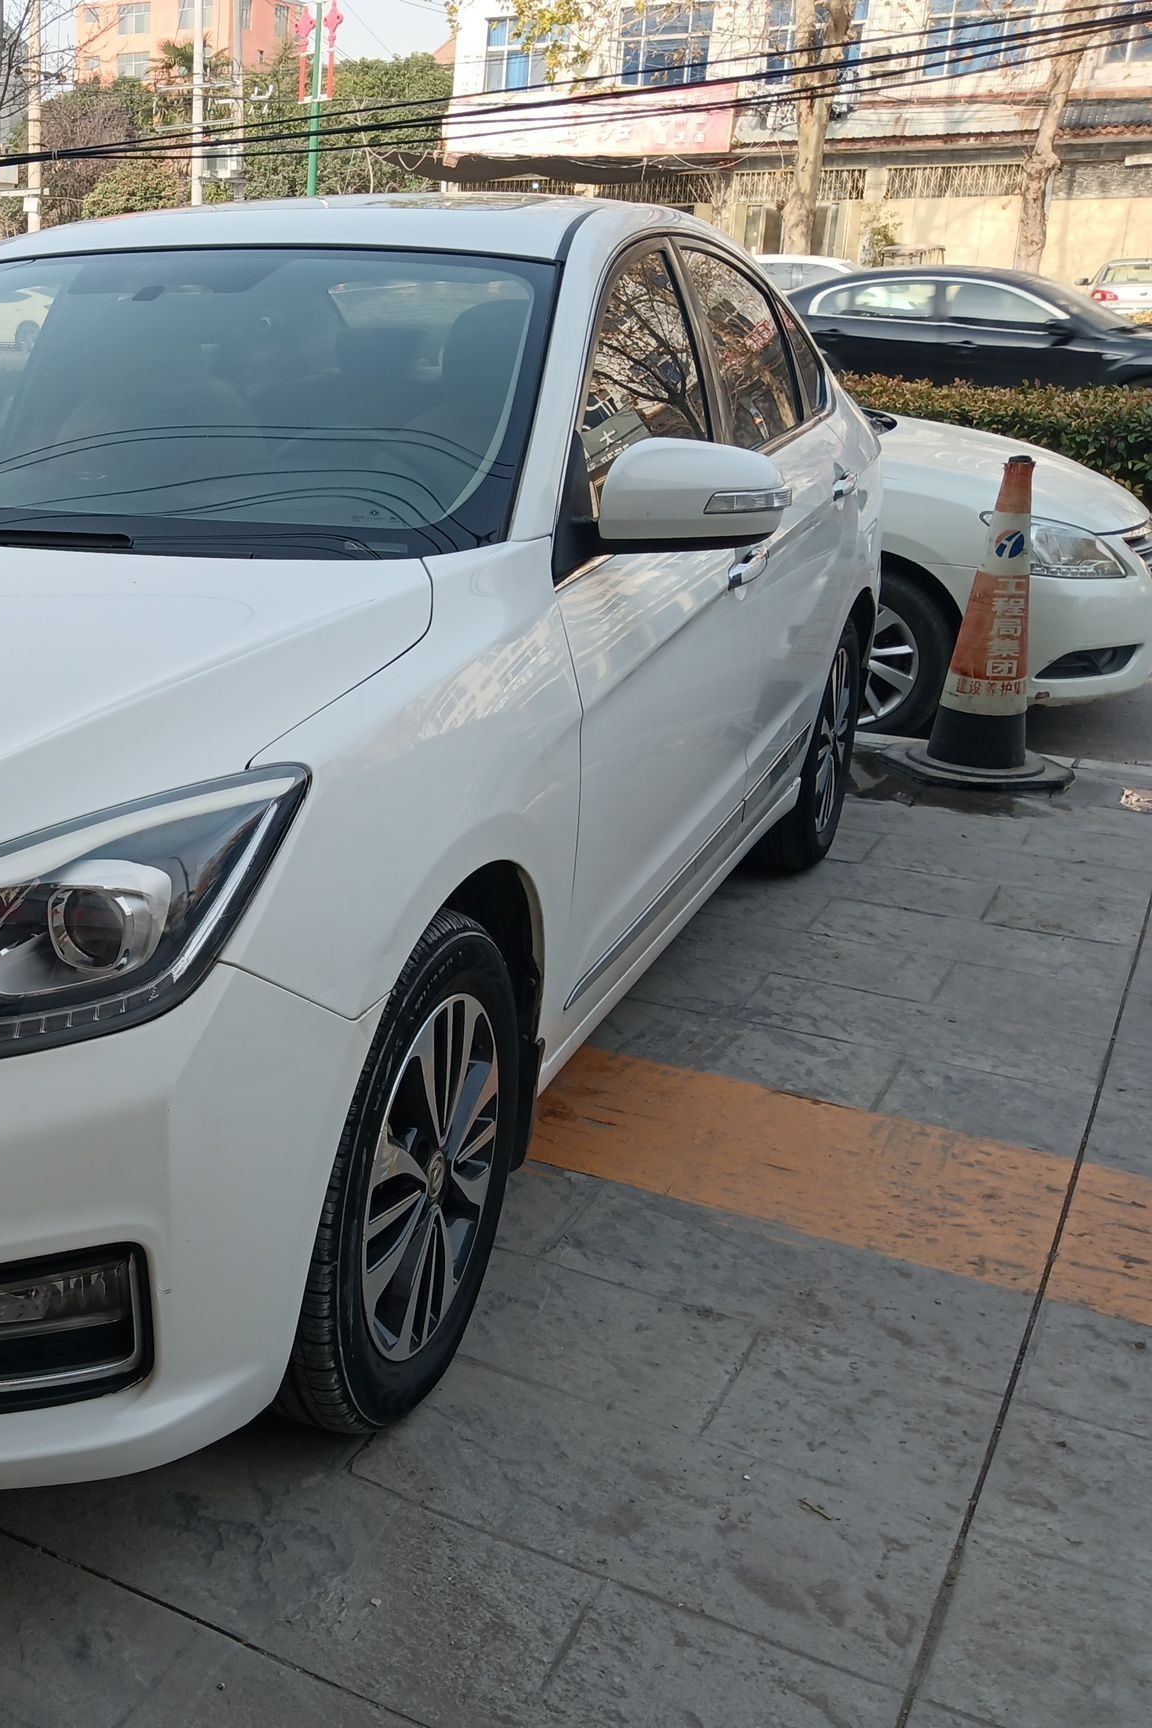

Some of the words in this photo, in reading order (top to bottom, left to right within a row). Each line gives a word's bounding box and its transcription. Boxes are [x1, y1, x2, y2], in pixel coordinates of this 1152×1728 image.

[986, 577, 1026, 678] 工程局集团
